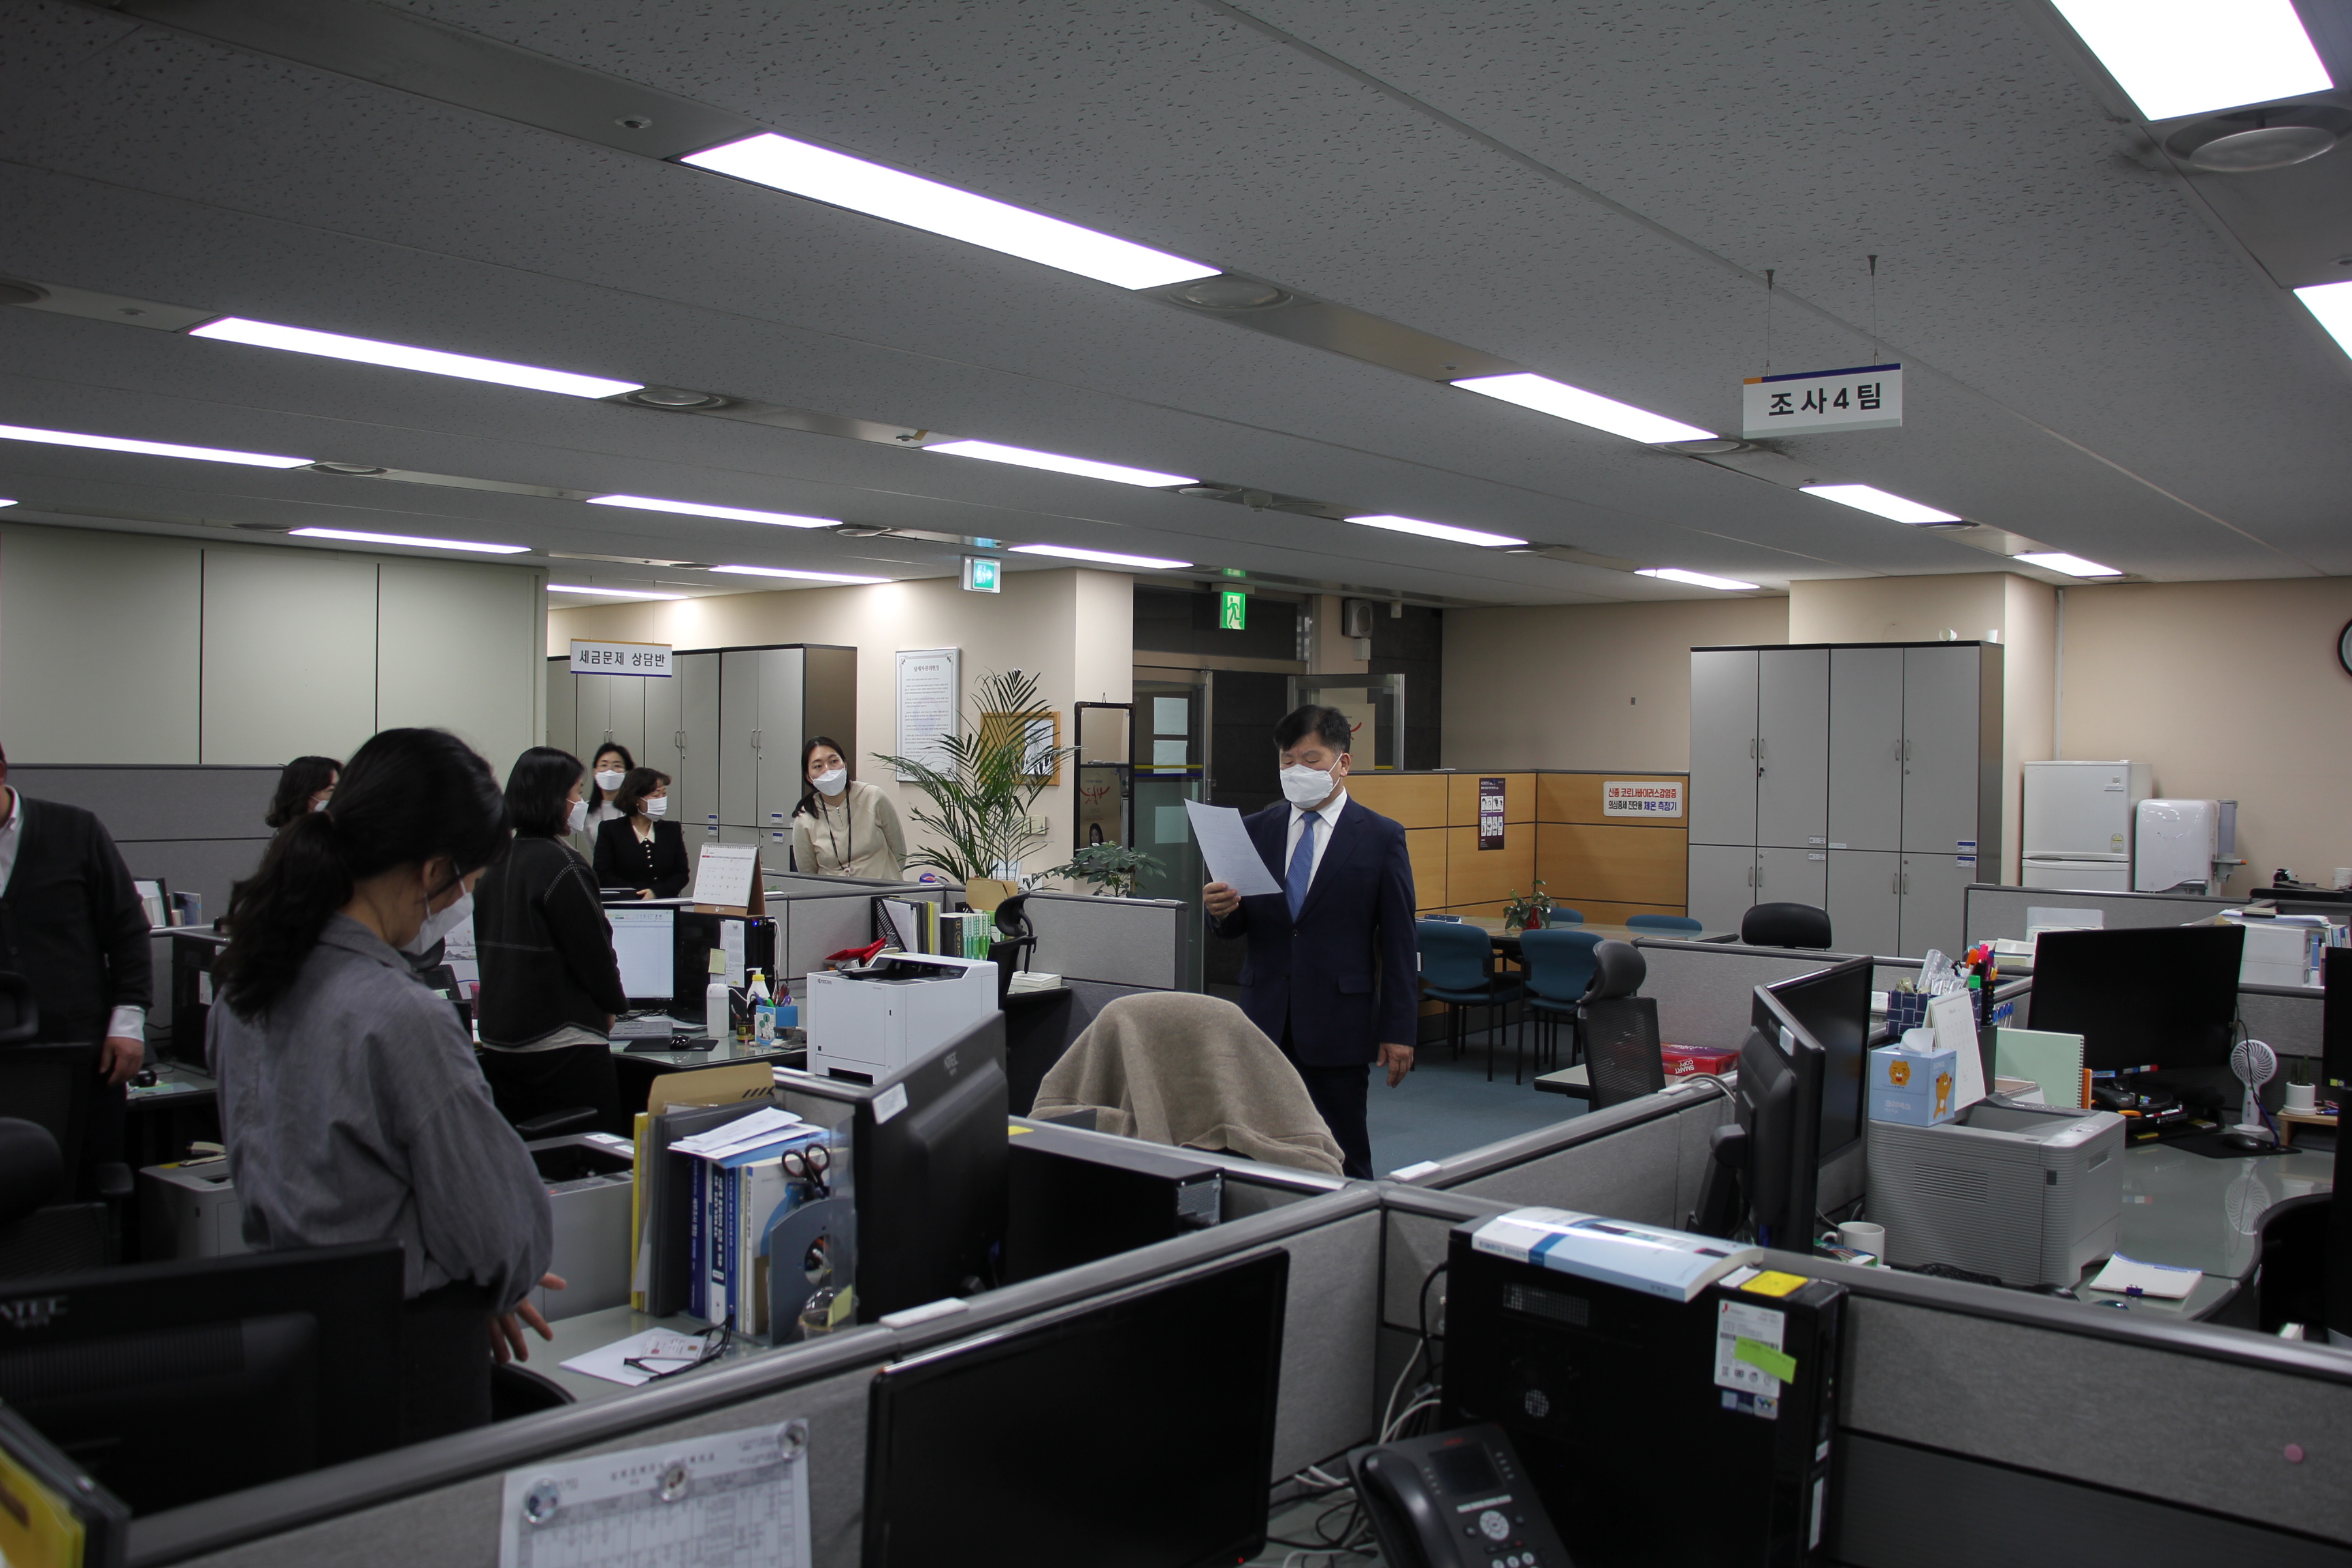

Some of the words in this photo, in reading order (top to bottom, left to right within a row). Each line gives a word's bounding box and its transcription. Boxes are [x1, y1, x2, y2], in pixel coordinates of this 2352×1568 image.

[1768, 382, 1880, 416] 조사4팀
[579, 650, 625, 666] 세금문제
[632, 652, 665, 667] 상담반
[1608, 787, 1620, 798] 신종
[1621, 788, 1677, 798] 코로나바이러스감염증
[1608, 800, 1627, 810] 의심증세
[1628, 801, 1643, 811] 진단용
[1644, 801, 1656, 811] 체온
[1658, 802, 1677, 811] 측정기
[1675, 1065, 1695, 1075] SMART
